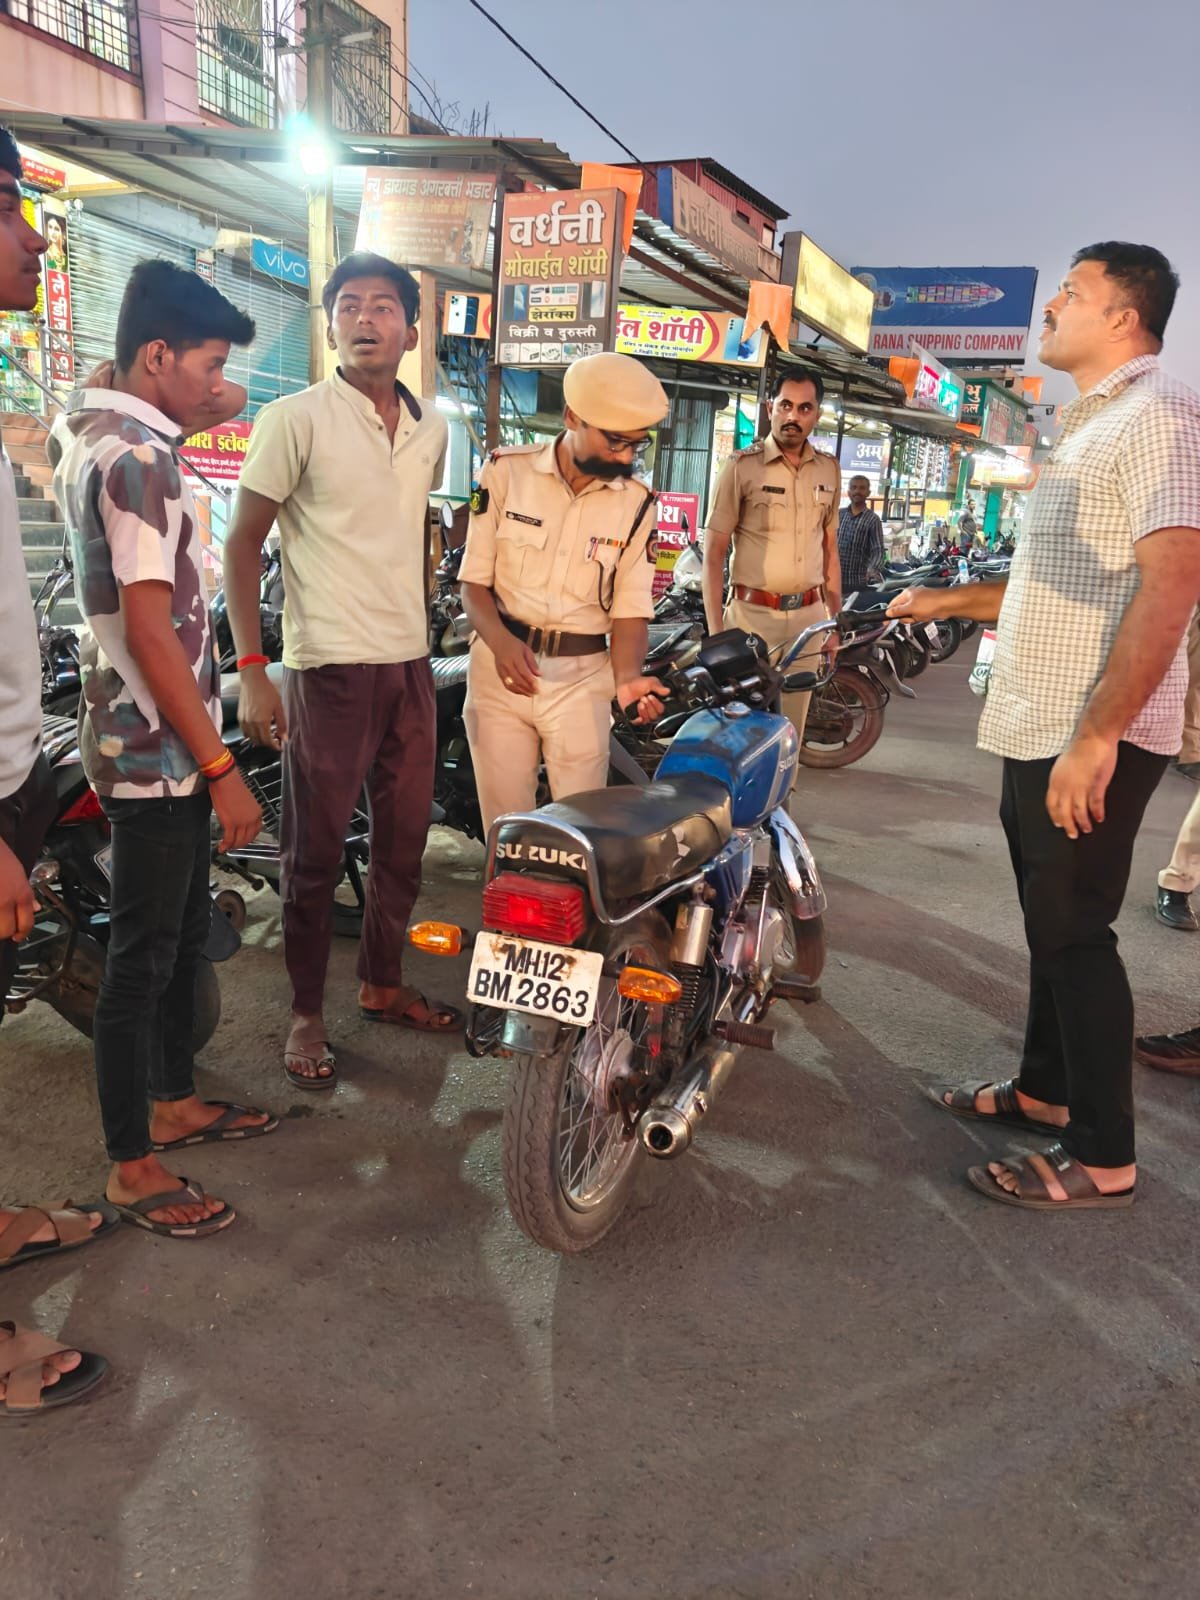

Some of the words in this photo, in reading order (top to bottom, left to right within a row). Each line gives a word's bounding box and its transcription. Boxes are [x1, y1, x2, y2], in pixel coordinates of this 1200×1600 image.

[509, 200, 605, 246] वर्धनी
[263, 250, 306, 278] vivo
[504, 250, 564, 279] मोबाईल
[568, 247, 609, 276] शॉपी
[508, 325, 539, 338] विक्री
[544, 328, 553, 337] व
[648, 316, 705, 344] शॉपी
[874, 334, 904, 349] RANA
[907, 334, 961, 350] SHIPPING
[964, 334, 1024, 350] COMPANY
